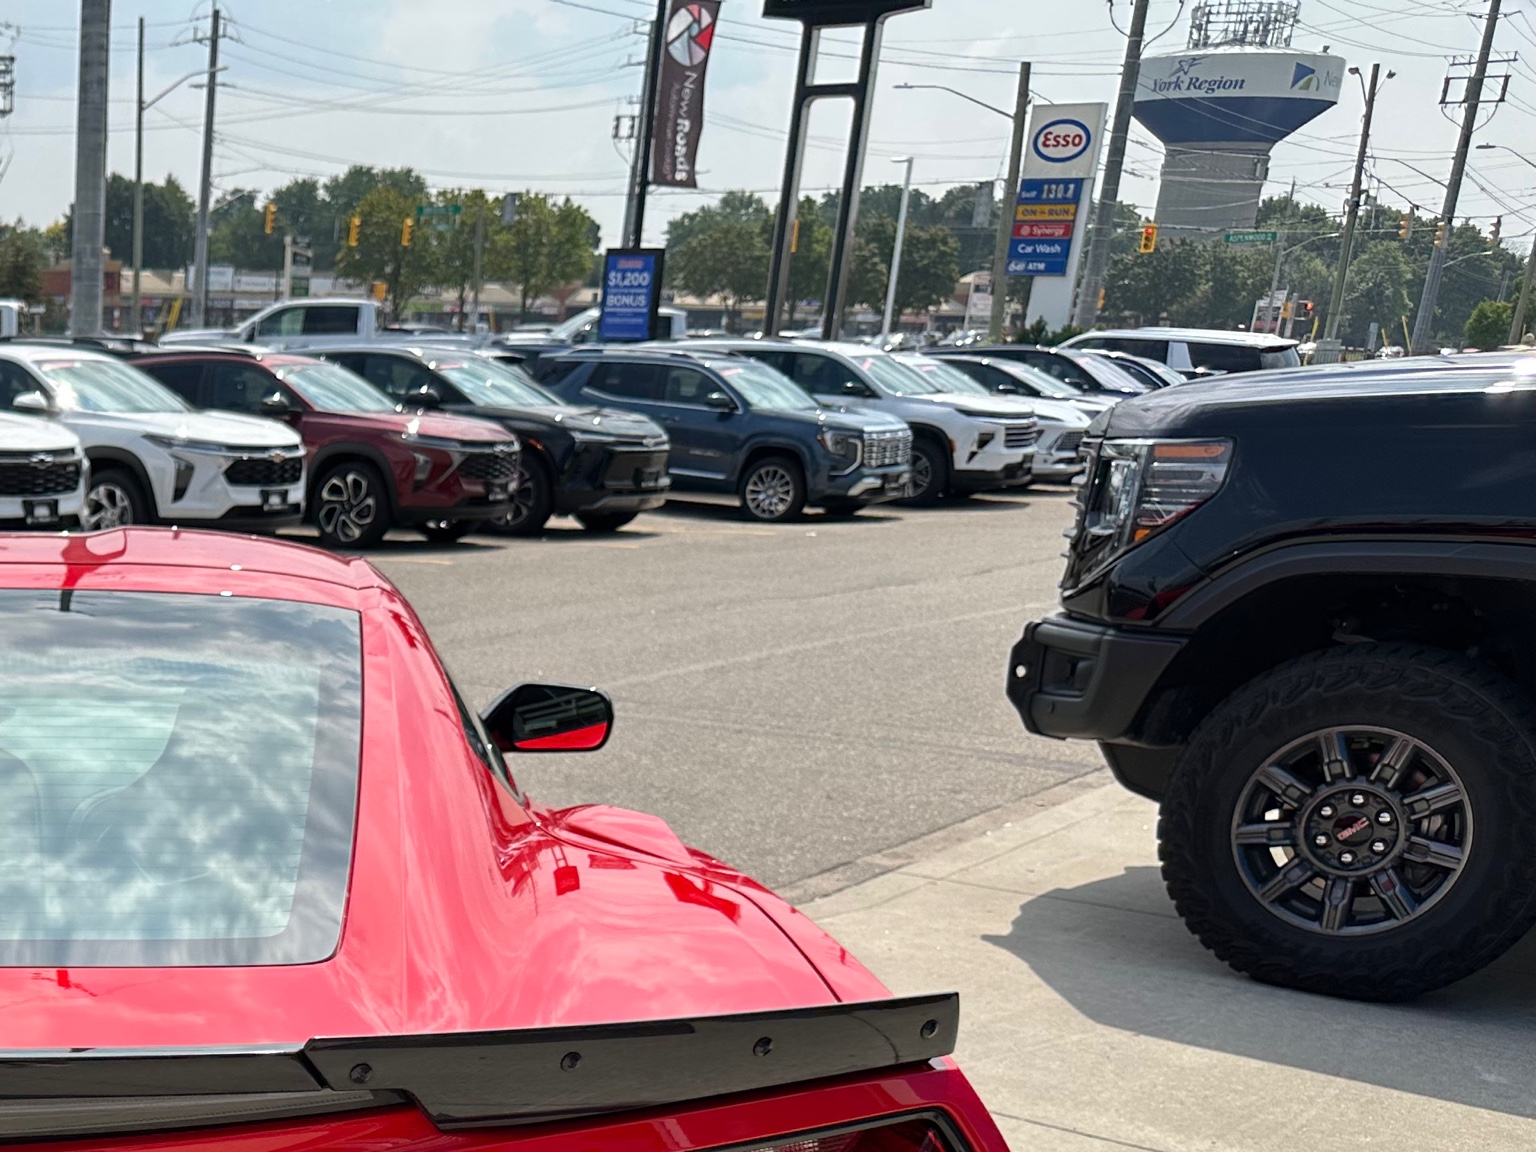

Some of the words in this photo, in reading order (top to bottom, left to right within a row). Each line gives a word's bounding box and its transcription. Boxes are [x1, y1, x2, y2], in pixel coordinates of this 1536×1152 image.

[1151, 76, 1184, 93] York
[1185, 76, 1245, 94] Region
[674, 71, 698, 182] NewRoads
[1041, 131, 1083, 148] Esso
[1032, 225, 1065, 237] Synergy
[1017, 243, 1034, 254] Car
[1035, 243, 1061, 254] Wash
[1027, 262, 1046, 270] ATM
[608, 270, 650, 287] $1,200
[606, 294, 647, 307] BONUS
[1337, 817, 1369, 840] GMC
